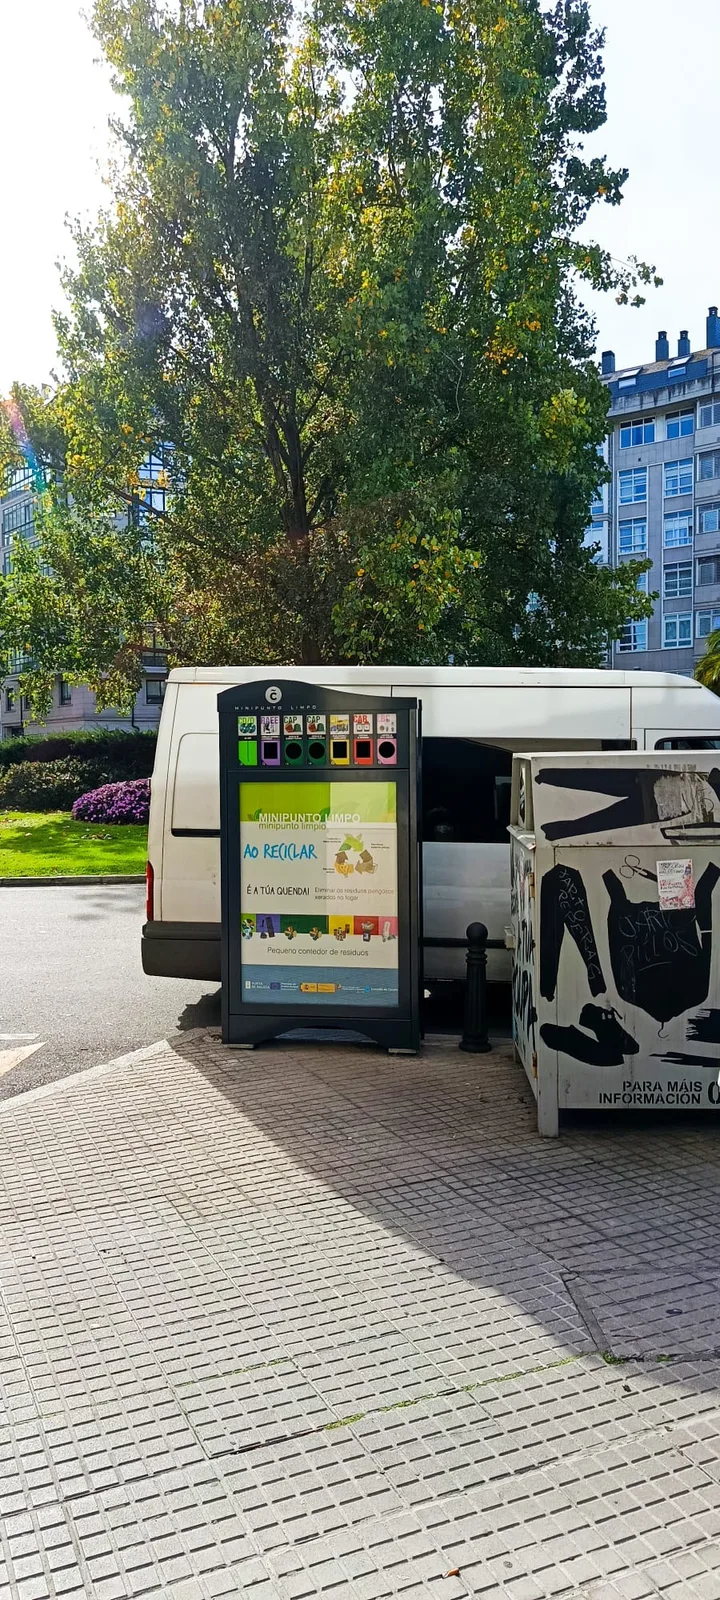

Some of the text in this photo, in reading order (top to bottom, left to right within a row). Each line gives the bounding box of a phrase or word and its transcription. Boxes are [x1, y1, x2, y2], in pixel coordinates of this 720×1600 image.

[258, 813, 361, 823] MINIPUNTO LIMPO
[258, 822, 327, 831] minipunto limpio
[263, 842, 318, 861] RECICLAR
[246, 884, 252, 895] É
[253, 886, 259, 895] A
[260, 884, 275, 895] TÚA
[298, 947, 328, 955] contedor
[340, 949, 369, 957] residuos
[622, 1078, 703, 1092] PARA MÁIS
[599, 1091, 701, 1104] INFORMACIÓN
